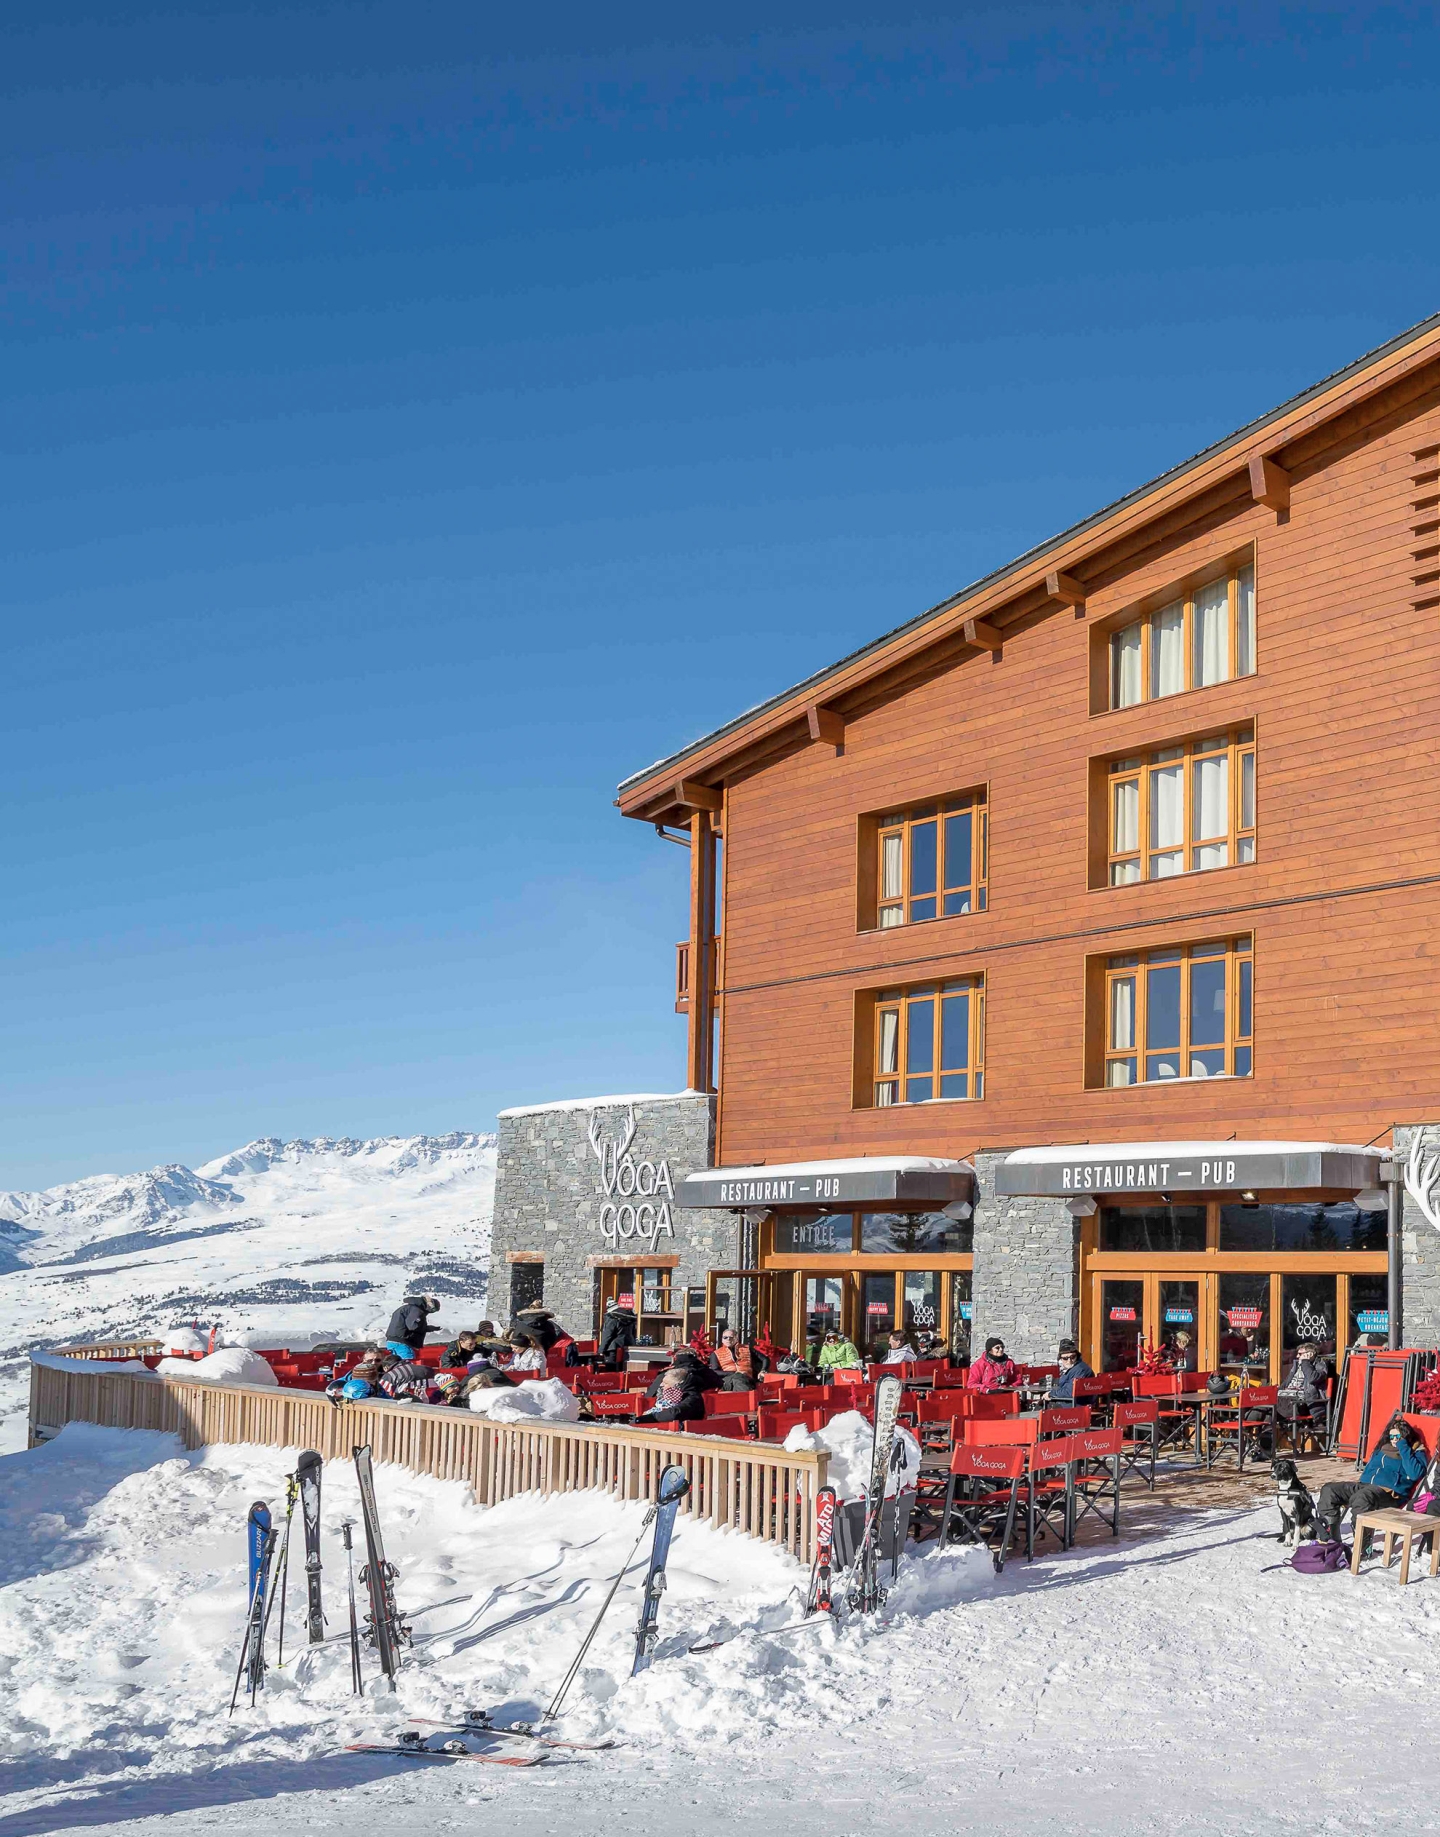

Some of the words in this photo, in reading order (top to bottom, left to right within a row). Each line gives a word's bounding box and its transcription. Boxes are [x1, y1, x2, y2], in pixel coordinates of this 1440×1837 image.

[1062, 1163, 1170, 1189] RESTAURANT
[1201, 1161, 1236, 1184] PUB
[720, 1180, 796, 1202] RESTAURANT
[815, 1178, 840, 1198] PUB
[600, 1203, 674, 1251] GOGA
[1296, 1326, 1327, 1340] GOGA
